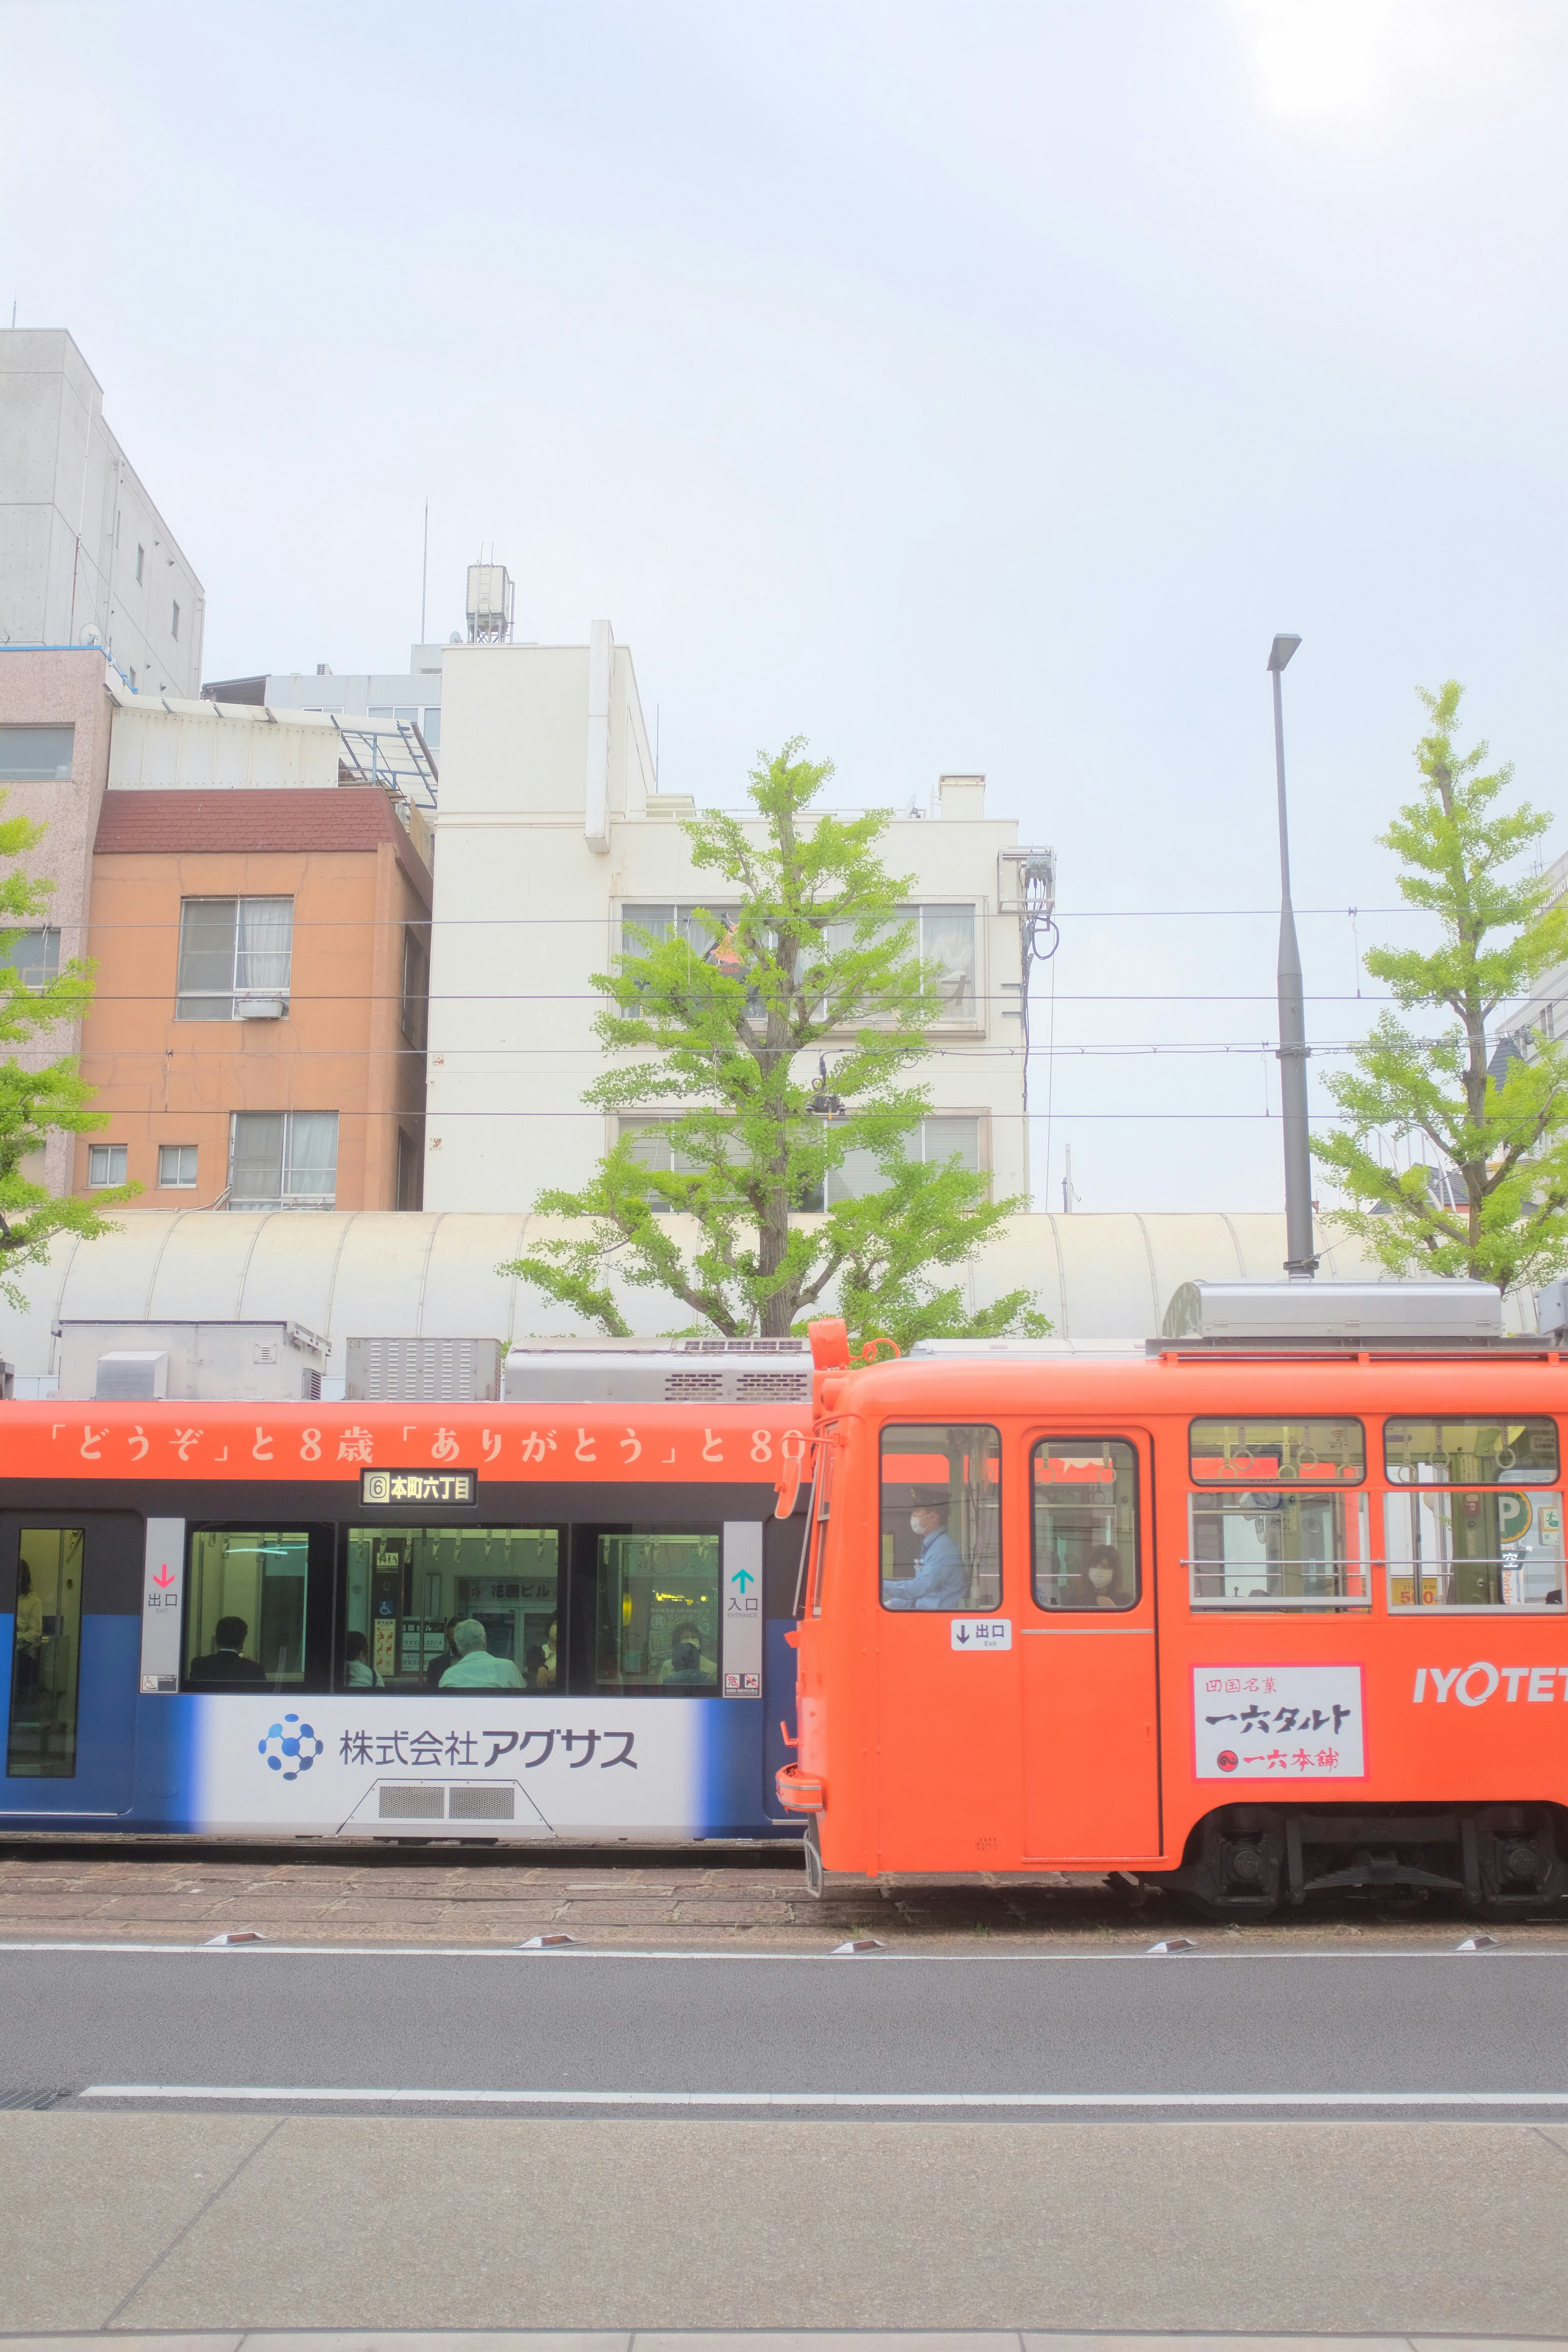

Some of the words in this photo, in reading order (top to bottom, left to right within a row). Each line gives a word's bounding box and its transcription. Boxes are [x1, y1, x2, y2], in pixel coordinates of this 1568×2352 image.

[391, 1476, 469, 1499] 本町六丁目
[1503, 1553, 1518, 1567] 空
[149, 1593, 177, 1607] 出口
[728, 1598, 758, 1611] 入口
[976, 1624, 1004, 1638] 出口
[1206, 1677, 1277, 1694] 四国名菓
[1205, 1704, 1351, 1735] 一六タルト
[339, 1729, 638, 1770] 株式会社アグサス
[1243, 1747, 1339, 1772] 一六本舗
